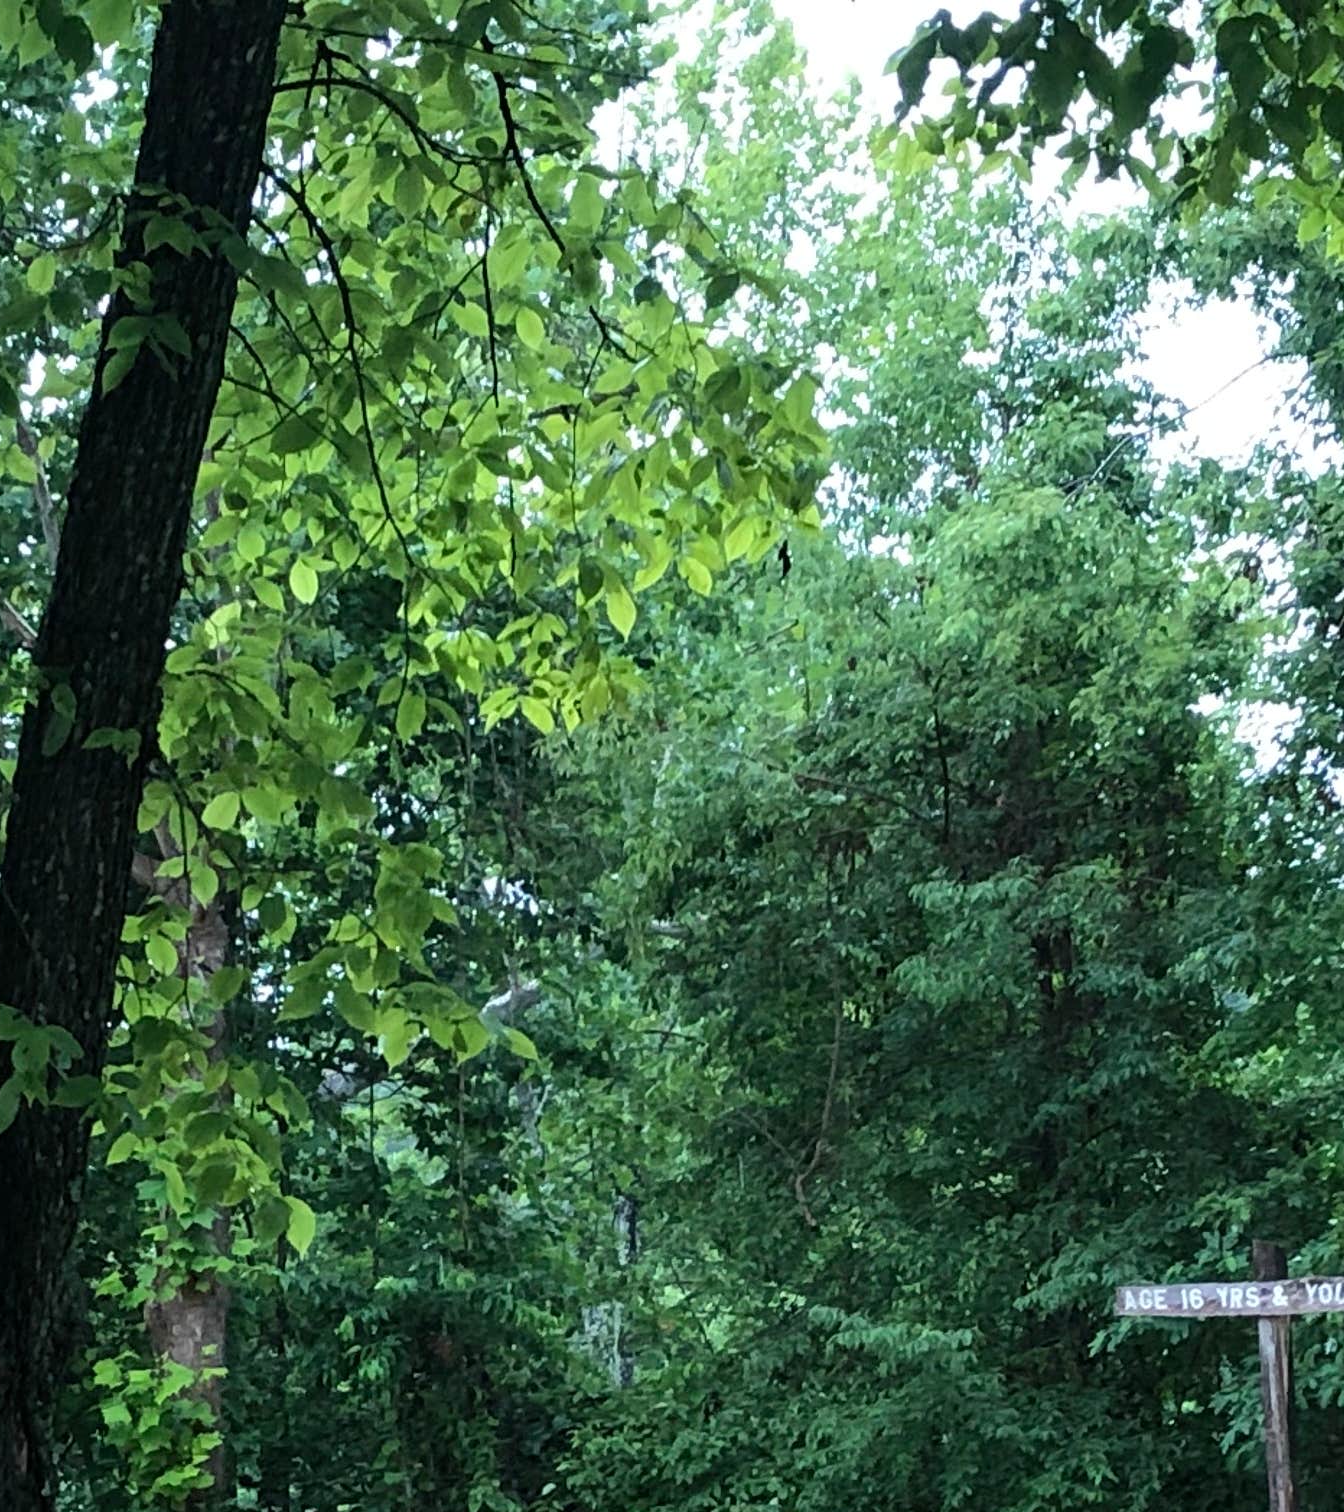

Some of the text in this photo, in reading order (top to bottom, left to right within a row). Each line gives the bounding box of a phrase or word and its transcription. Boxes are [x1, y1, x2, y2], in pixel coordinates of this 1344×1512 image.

[1123, 1288, 1169, 1312] AGE
[1179, 1288, 1205, 1310] 16
[1217, 1286, 1259, 1310] YRS
[1271, 1286, 1289, 1307] &
